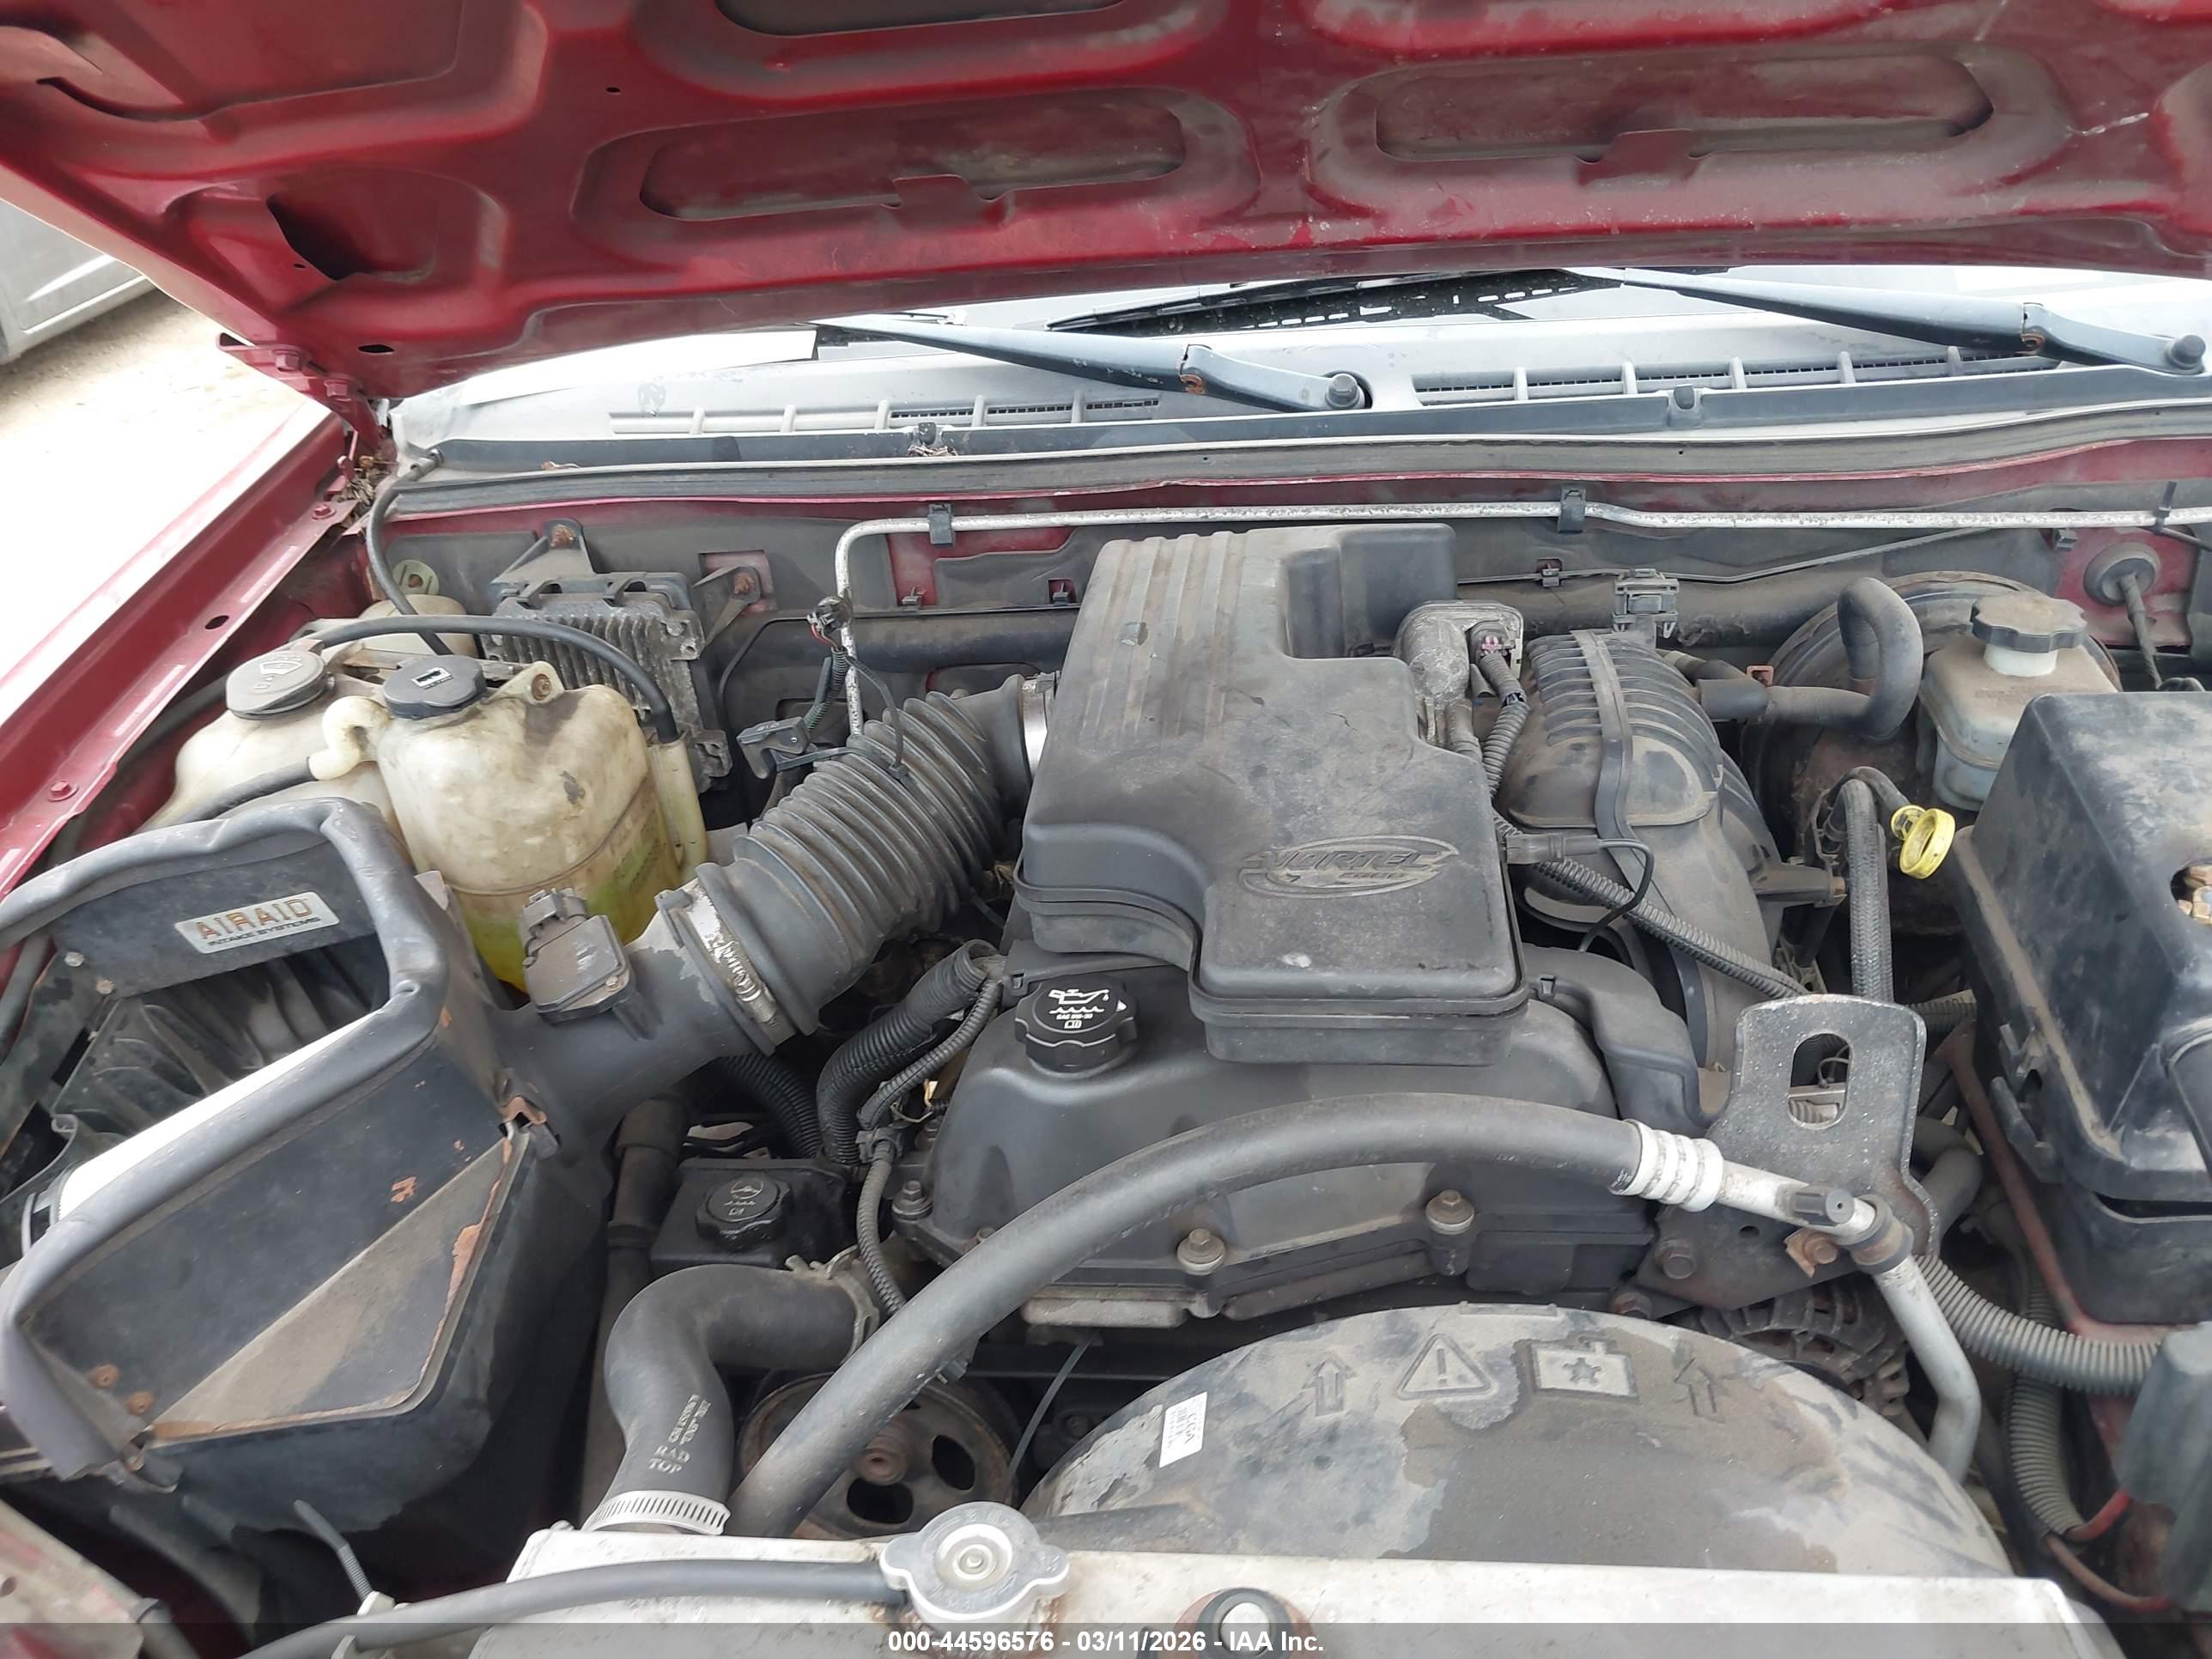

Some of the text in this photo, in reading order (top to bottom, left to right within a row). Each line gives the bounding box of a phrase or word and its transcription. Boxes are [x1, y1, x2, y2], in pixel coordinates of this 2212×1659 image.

[196, 898, 313, 940] AIRAID
[208, 917, 321, 946] INTAKE SYSTEMS
[654, 1445, 690, 1462] RAD
[648, 1457, 682, 1474] TOP
